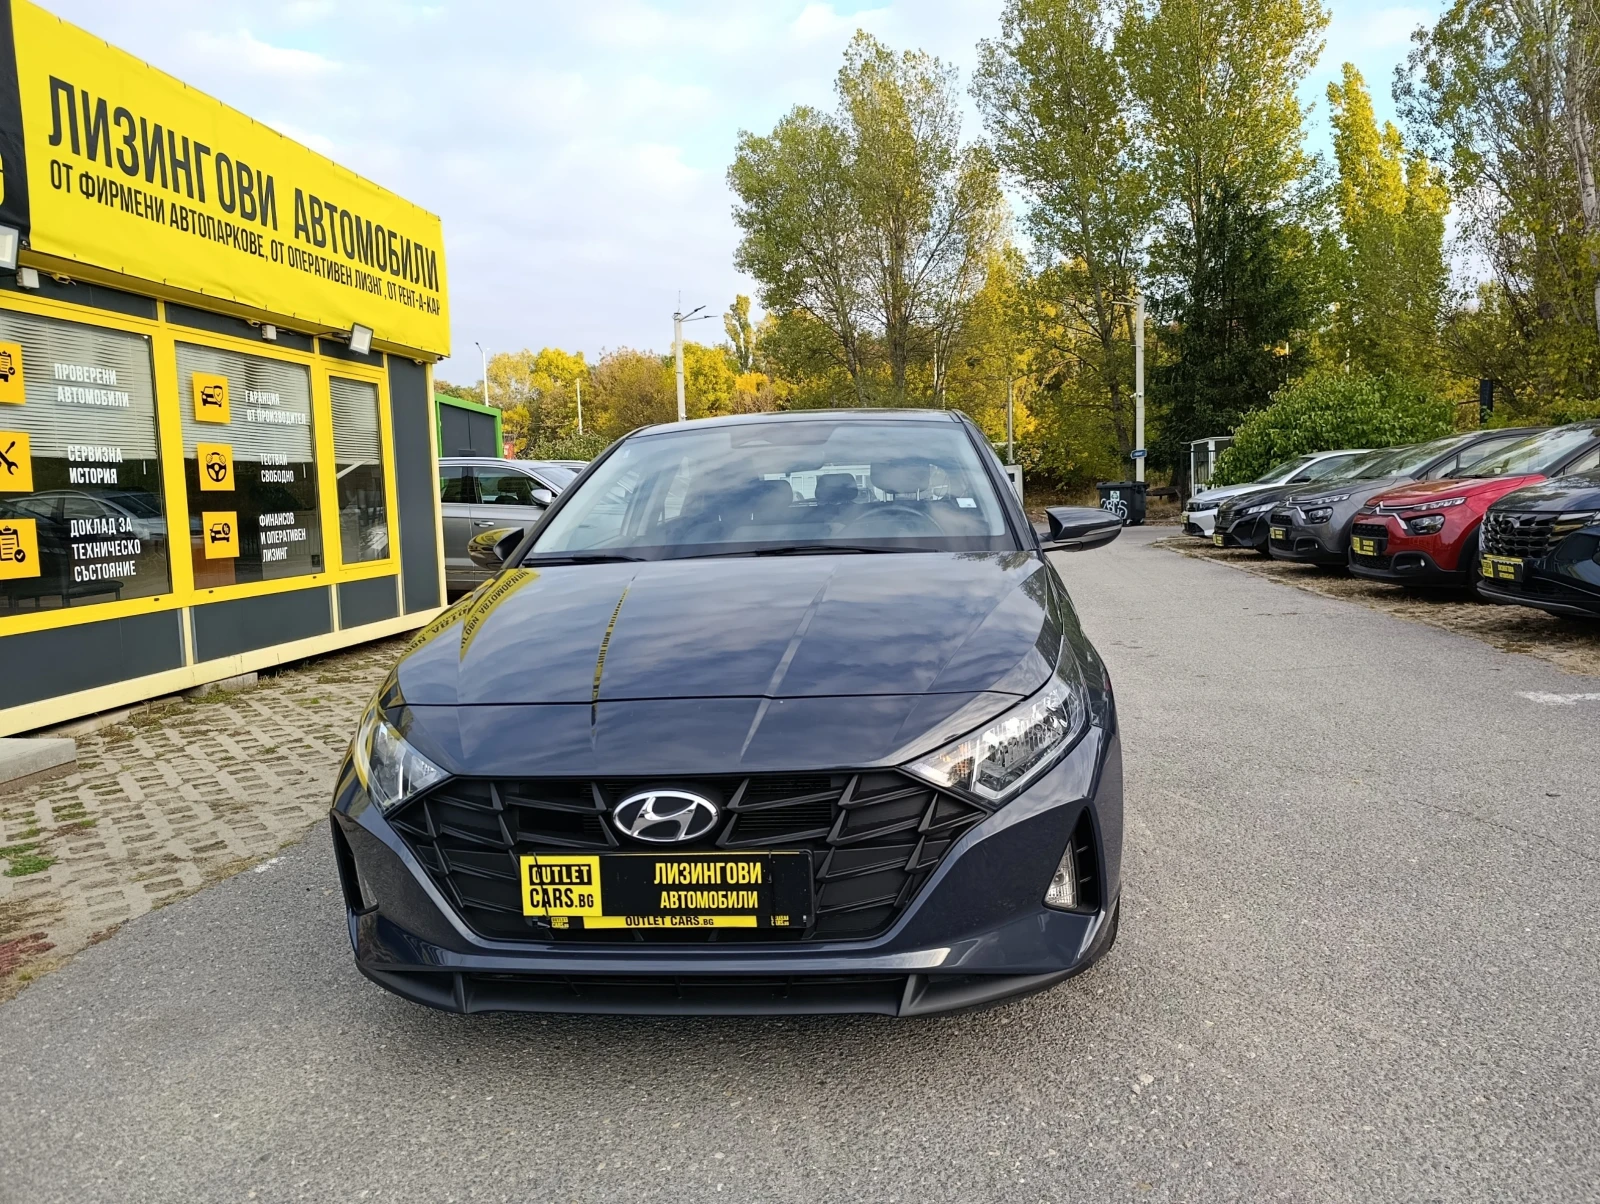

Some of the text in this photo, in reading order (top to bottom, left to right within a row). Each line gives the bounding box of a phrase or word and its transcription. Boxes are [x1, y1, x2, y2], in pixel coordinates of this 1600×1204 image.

[48, 75, 278, 231] ЛИЗИНГОВИ
[294, 187, 439, 292] АВТОМОБИЛИ
[50, 159, 73, 193] ОТ
[79, 170, 165, 224] ФИРМЕНИ
[170, 203, 268, 262] АВТОПАРКОВЕ,
[270, 239, 285, 263] ОТ
[288, 245, 353, 287] ОПЕРАТИВЕН
[387, 281, 397, 301] ОТ
[398, 284, 441, 316] РЕНТ-А-КАР
[54, 363, 117, 385] ПРОВЕРЕНИ
[57, 386, 129, 408] АВТОМОБИЛИ
[245, 391, 280, 406] ГАРАНЦИЯ
[247, 410, 306, 425] ОТ ПРОИЗВОДИТЕЛ
[67, 445, 123, 463] СЕРВИЗНА
[260, 452, 288, 466] ТЕСТВАЙ
[69, 467, 118, 484] ИСТОРИЯ
[261, 469, 294, 483] СВОБОДНО
[70, 517, 133, 538] ДОКЛАД ЗА
[259, 512, 295, 527] ФИНАНСОВ
[260, 528, 306, 544] И ОПЕРАТИВЕН
[72, 539, 141, 560] ТЕХНИЧЕСКО
[262, 547, 288, 563] ЛИЗИНГ
[74, 560, 137, 582] СЪСТОЯНИЕ
[531, 865, 590, 884] OUTLET
[654, 862, 762, 885] ЛИЗИНГОВИ
[529, 888, 595, 909] CARS.BG
[660, 891, 759, 909] АВТОМОБИЛИ
[625, 916, 714, 927] OUTLET CARS.BG
